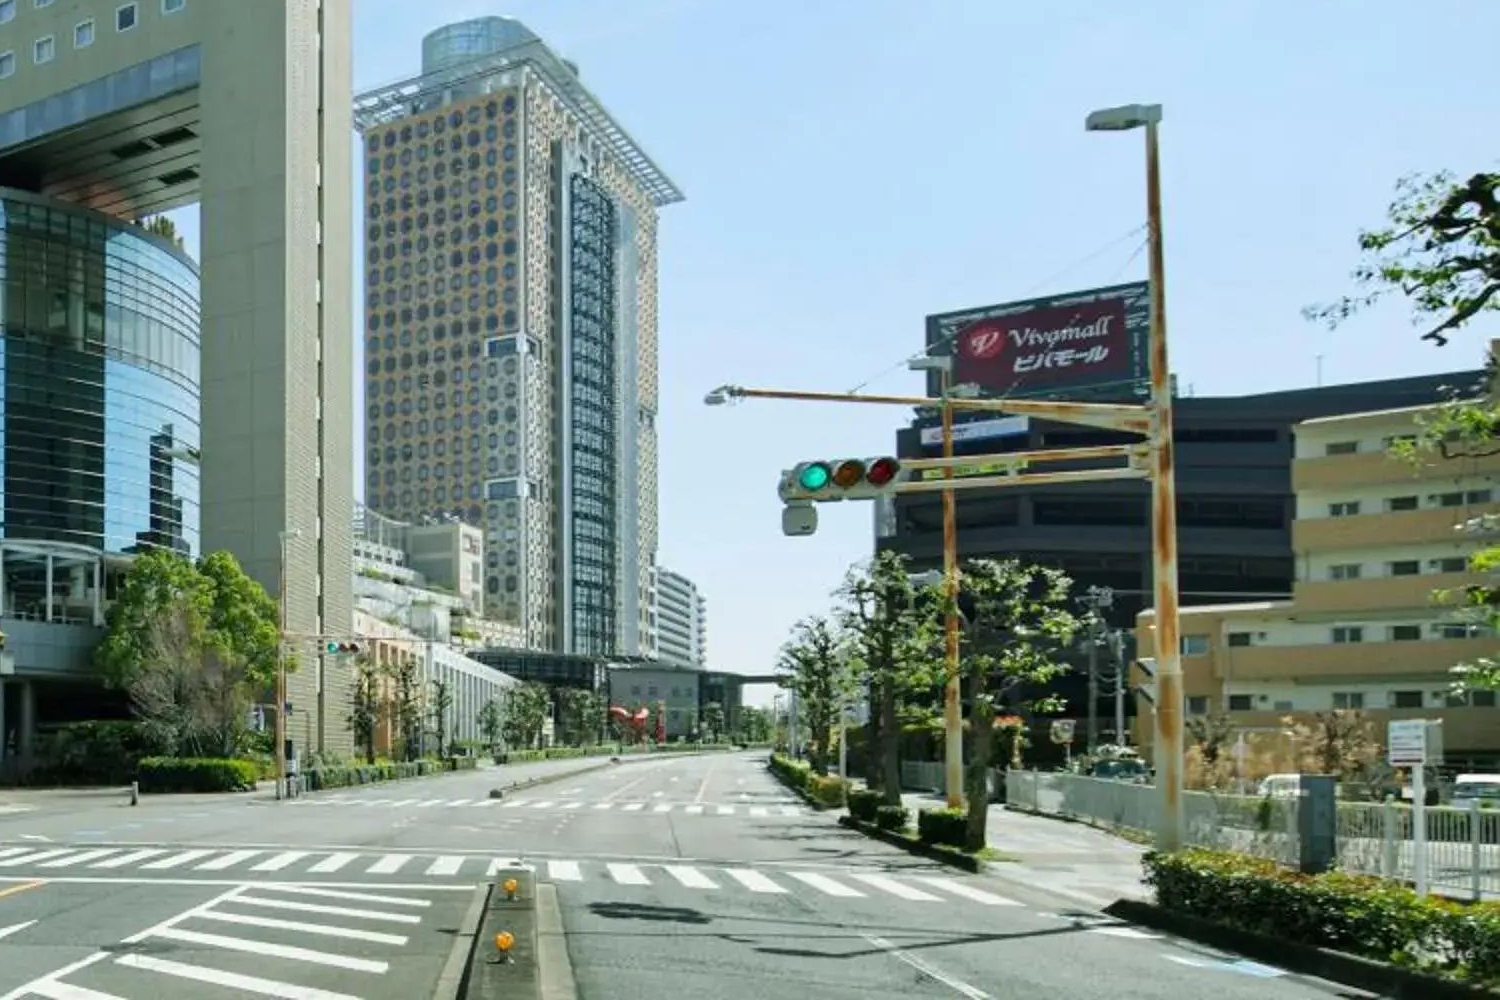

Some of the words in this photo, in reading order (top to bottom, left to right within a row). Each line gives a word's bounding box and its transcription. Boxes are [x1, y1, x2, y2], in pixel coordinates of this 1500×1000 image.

[1012, 345, 1109, 373] ビバモール
